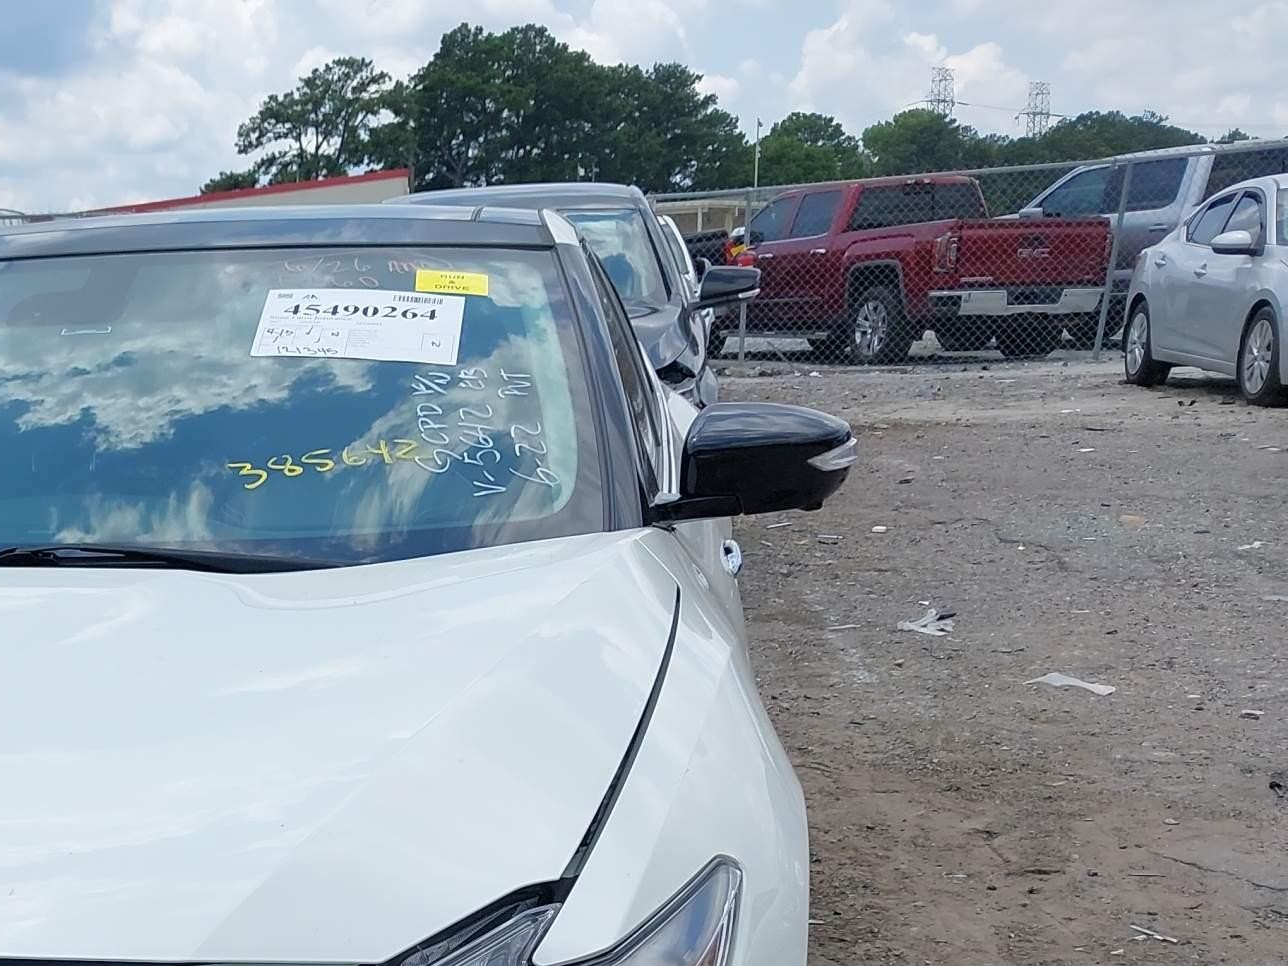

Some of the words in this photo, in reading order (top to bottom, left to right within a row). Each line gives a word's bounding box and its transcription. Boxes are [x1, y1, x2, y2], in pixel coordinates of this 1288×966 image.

[434, 283, 470, 291] DRIVE
[283, 303, 438, 321] 45490264
[226, 438, 429, 490] 385642
